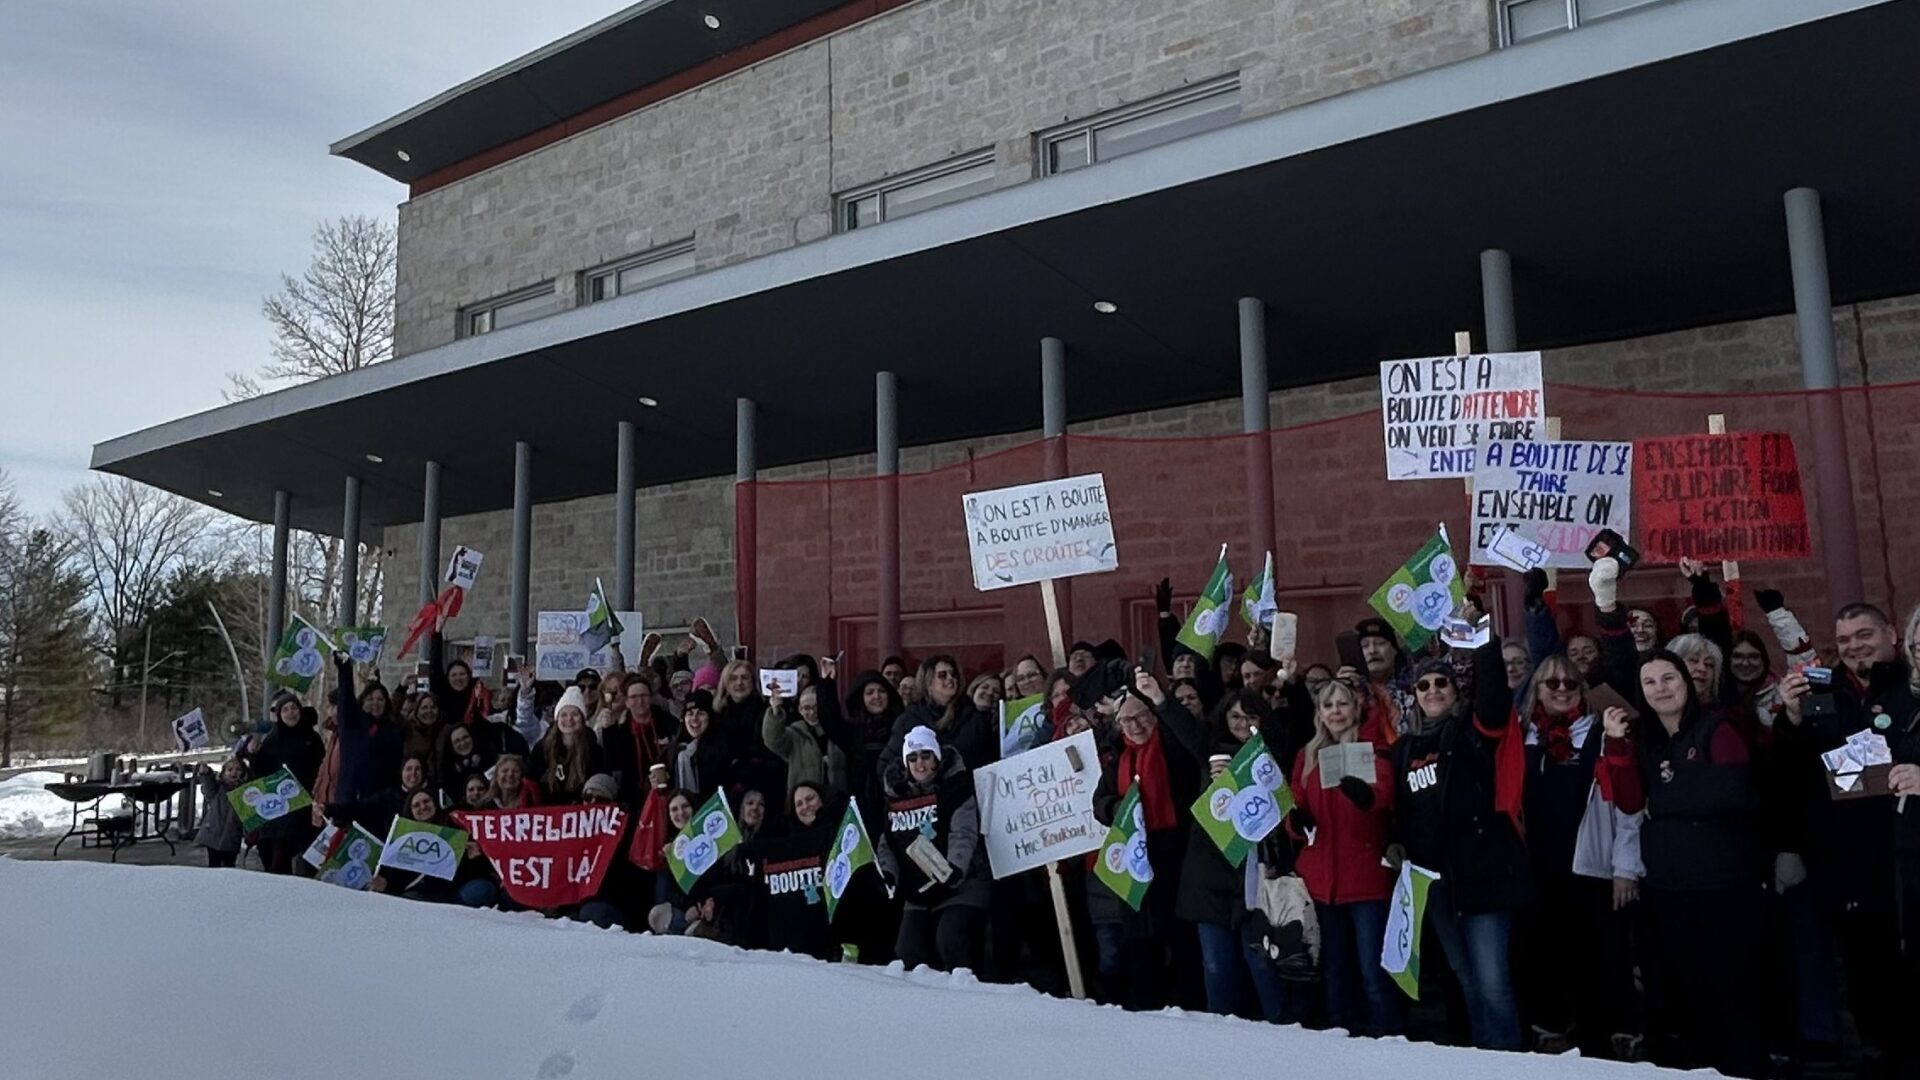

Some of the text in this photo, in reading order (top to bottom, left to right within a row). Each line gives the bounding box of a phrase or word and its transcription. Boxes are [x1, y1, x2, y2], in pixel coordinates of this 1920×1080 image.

[1388, 361, 1421, 394] ON
[1431, 357, 1469, 391] EST
[1387, 394, 1445, 424] BOUTTE
[1387, 425, 1411, 448] ON
[1417, 424, 1457, 448] VEUT
[1430, 448, 1477, 473] ENTE
[1509, 441, 1582, 472] BOUTTE
[1516, 470, 1569, 494] TAIRE
[983, 502, 1007, 523] ON
[1012, 495, 1040, 519] EST
[1477, 489, 1613, 525] ENSEMBLE ON
[990, 521, 1048, 544] BOUTTE
[985, 550, 1019, 572] DES
[1239, 796, 1269, 827] ACA
[399, 836, 442, 859] ACA
[509, 856, 554, 889] EST
